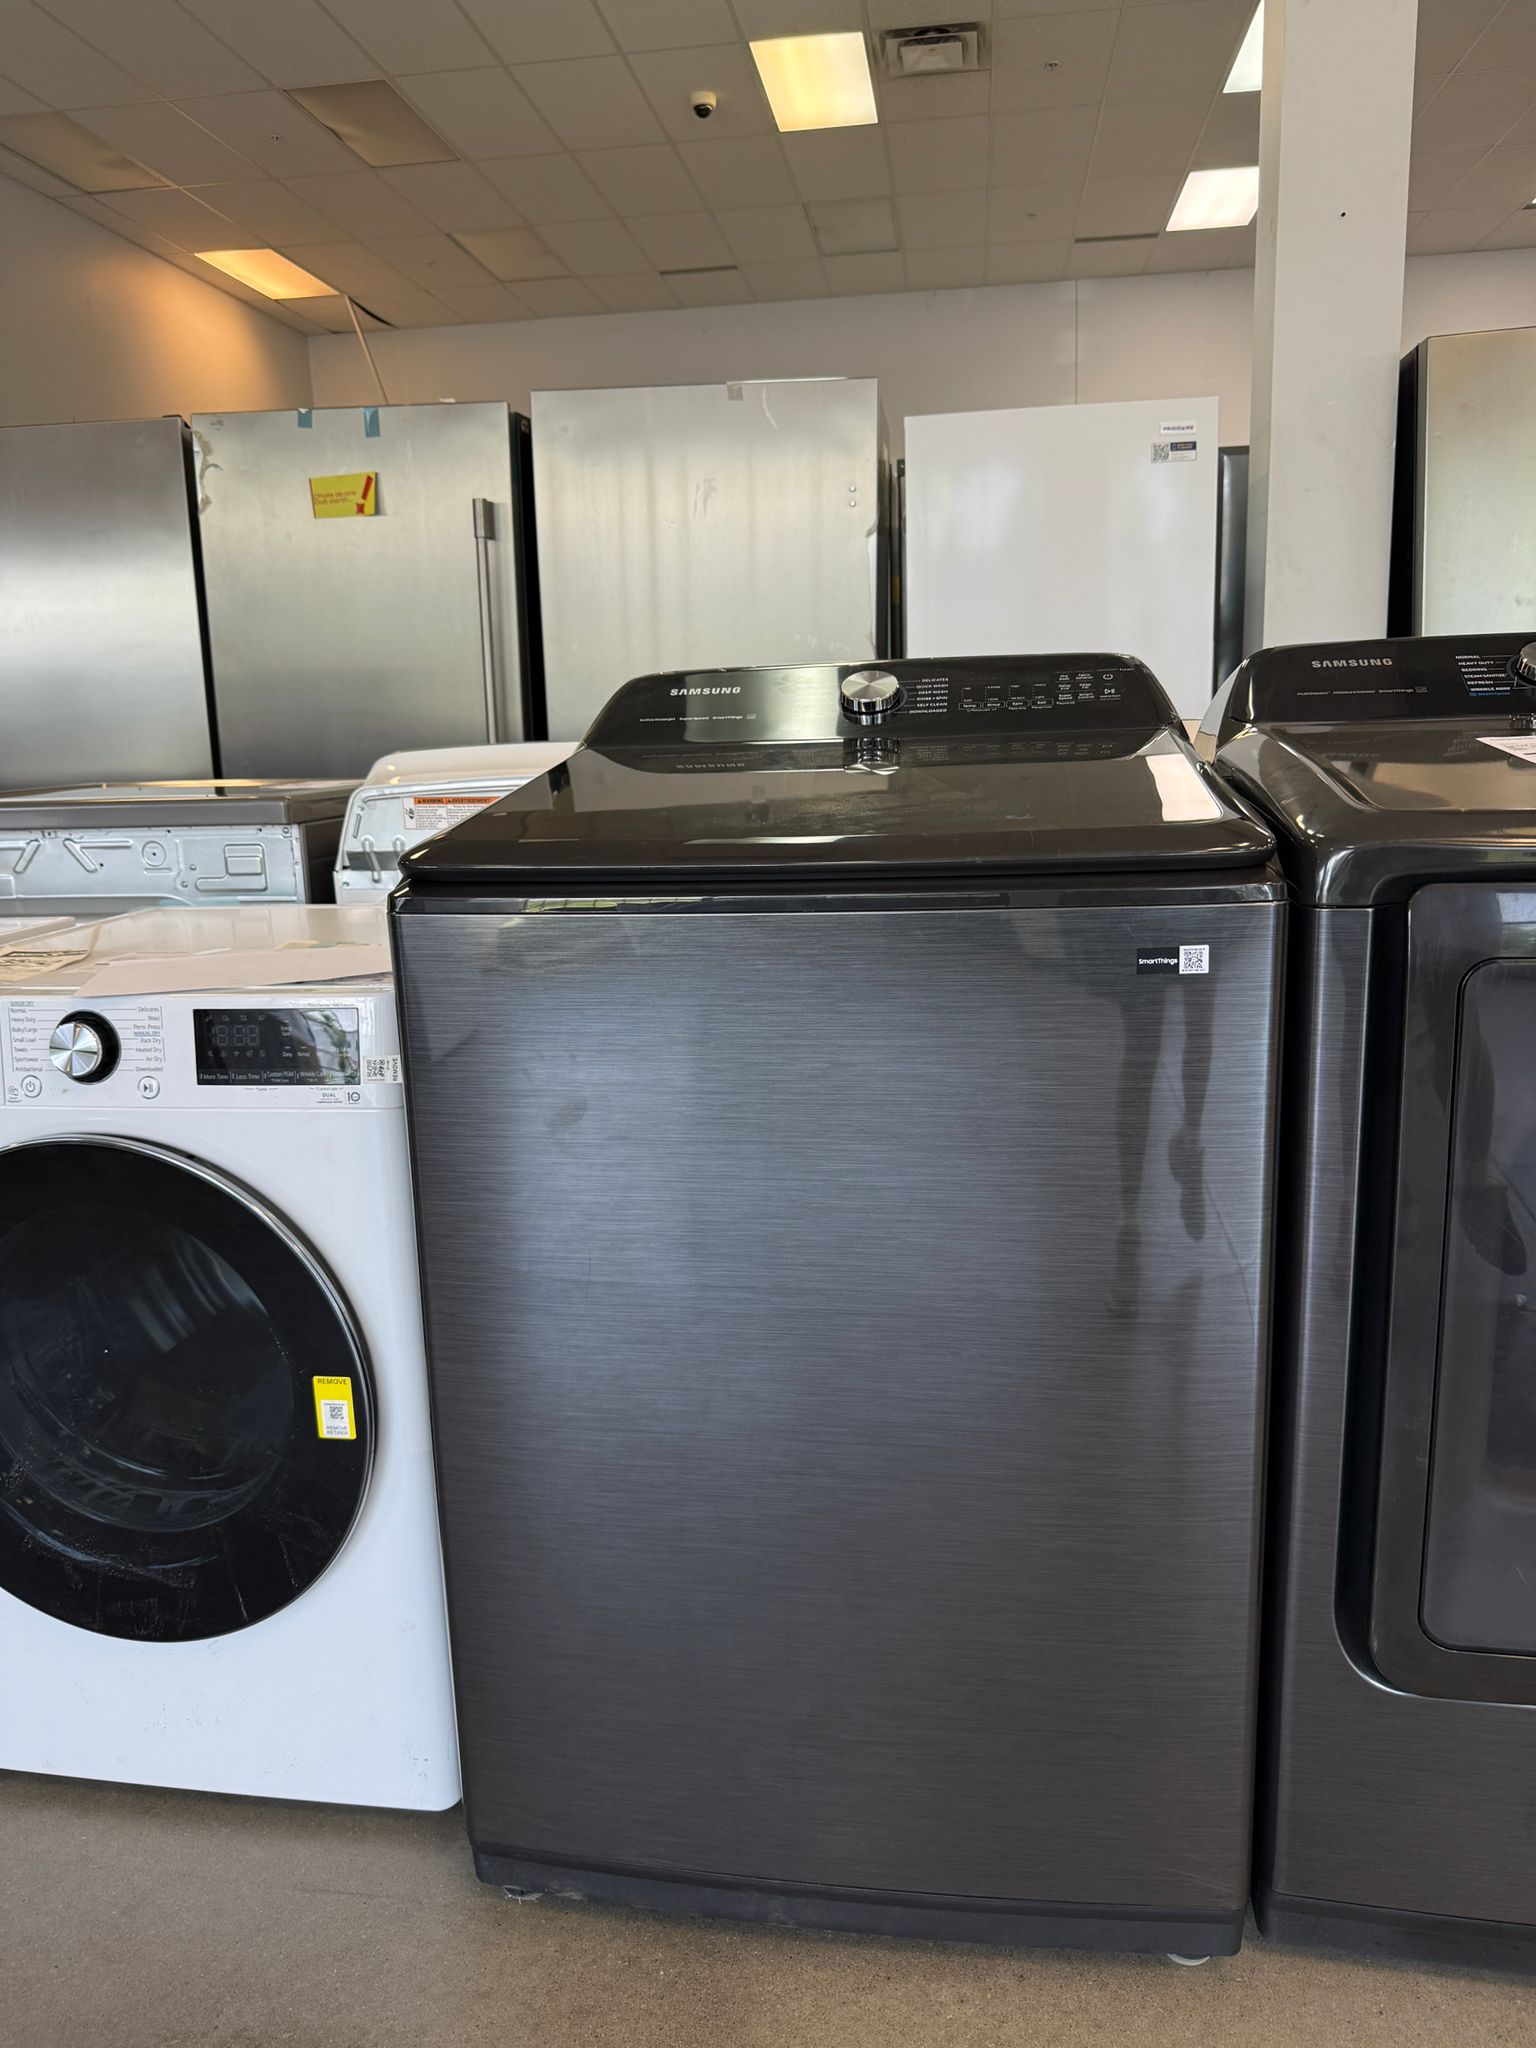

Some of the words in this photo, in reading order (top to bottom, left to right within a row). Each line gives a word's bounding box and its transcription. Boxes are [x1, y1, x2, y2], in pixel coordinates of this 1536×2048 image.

[1311, 657, 1393, 669] SAMSUNG
[669, 686, 742, 697] SAMSUNG
[1138, 957, 1179, 966] SmartThings
